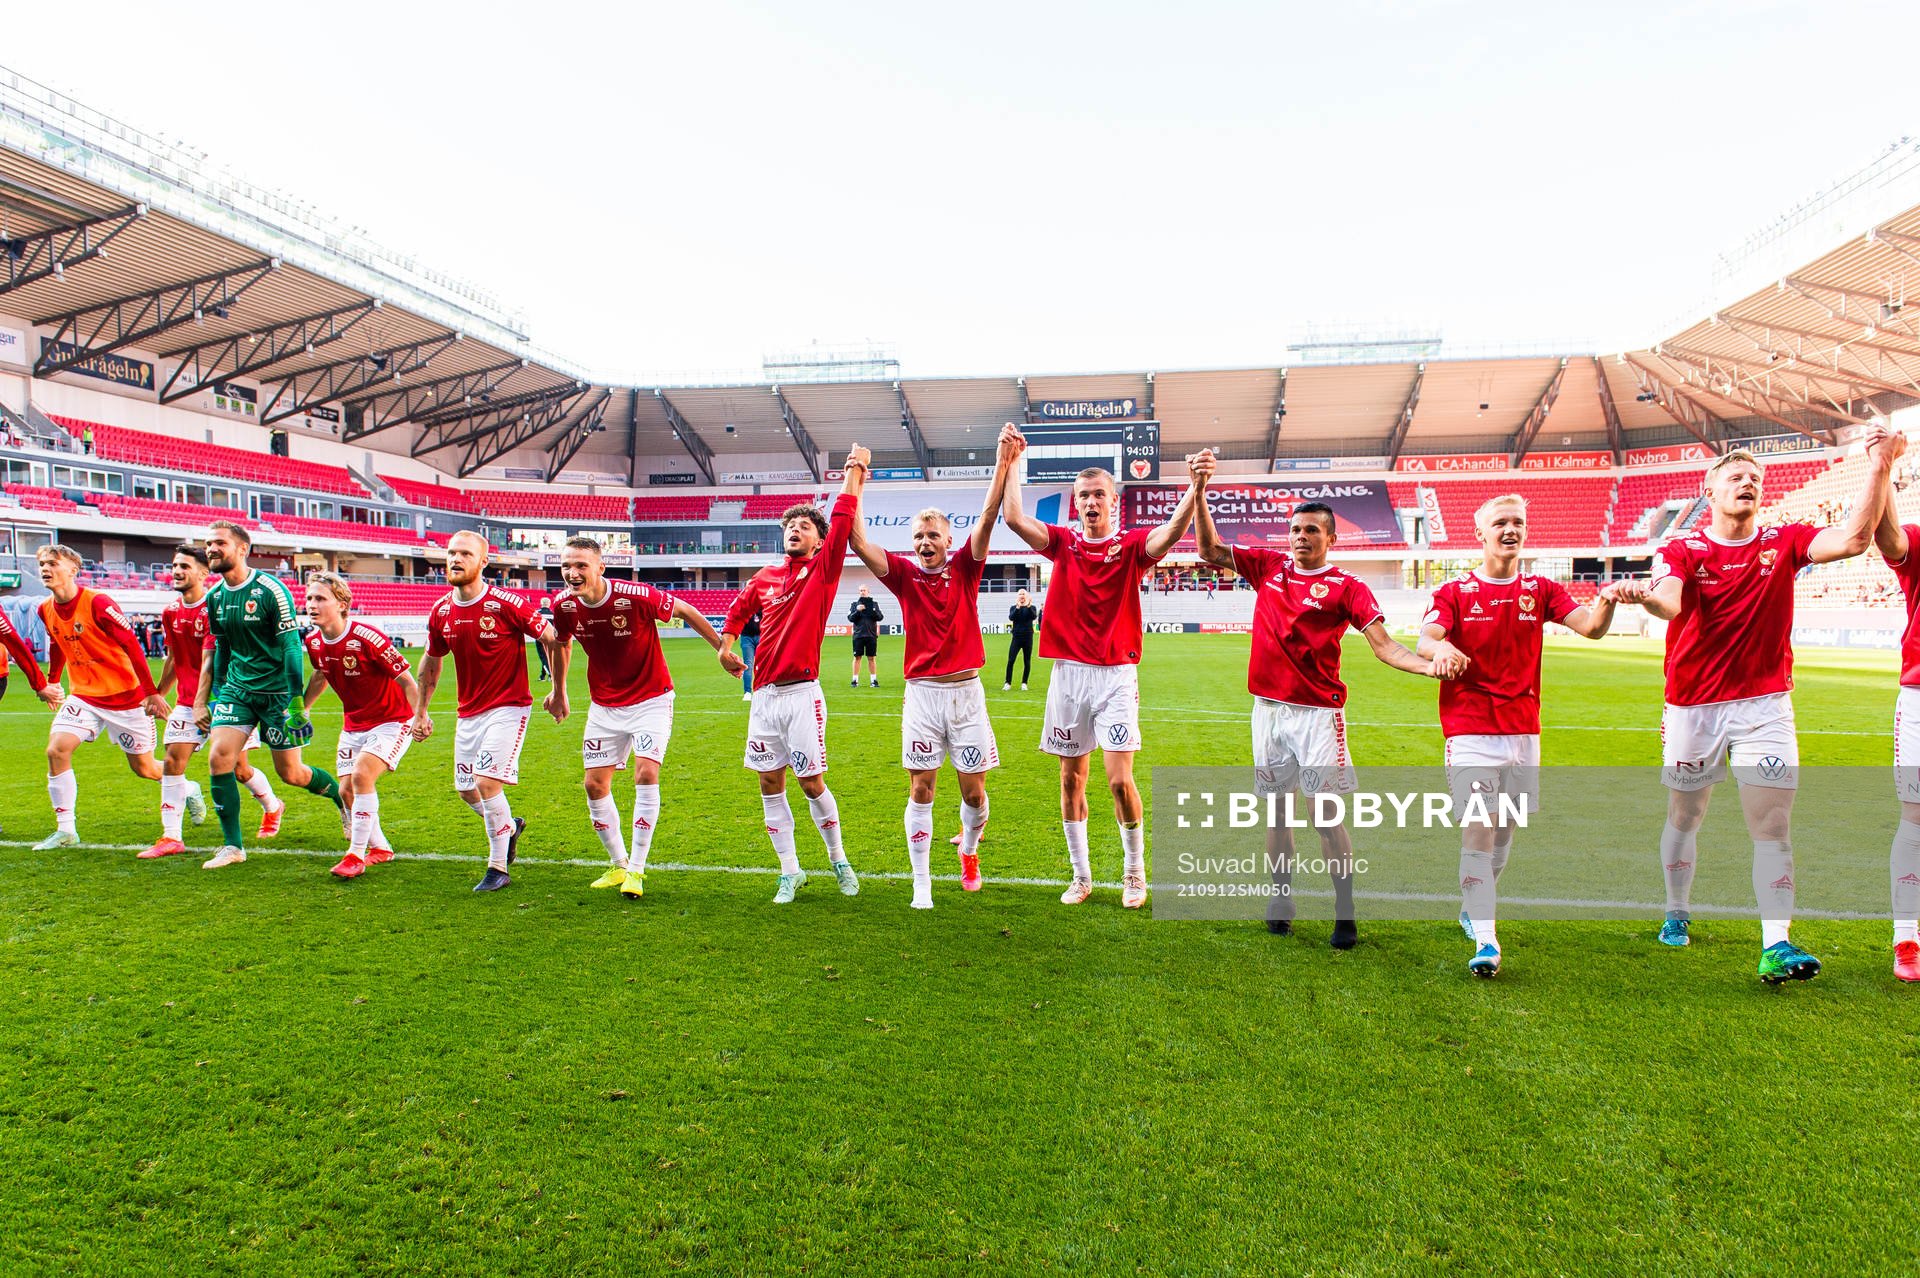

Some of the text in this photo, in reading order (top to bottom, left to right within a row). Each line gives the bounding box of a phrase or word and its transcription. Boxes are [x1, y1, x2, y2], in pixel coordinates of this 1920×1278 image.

[1043, 400, 1123, 418] GuldFågeln
[1126, 433, 1133, 441] 4
[1149, 432, 1153, 441] 1
[1126, 446, 1154, 456] 94:03
[1628, 447, 1705, 466] Nybro ICA
[1403, 459, 1427, 471] ICA
[1436, 457, 1506, 471] ICA-handla
[1554, 455, 1597, 467] Kalmar
[1600, 455, 1610, 466] &
[1205, 489, 1250, 501] OCH
[1256, 485, 1373, 500] MOTGÅNG.
[1147, 502, 1178, 515] NÖ
[1208, 503, 1246, 514] OCH
[864, 515, 910, 526] ntuz
[824, 625, 847, 634] enta
[981, 624, 1000, 634] olit
